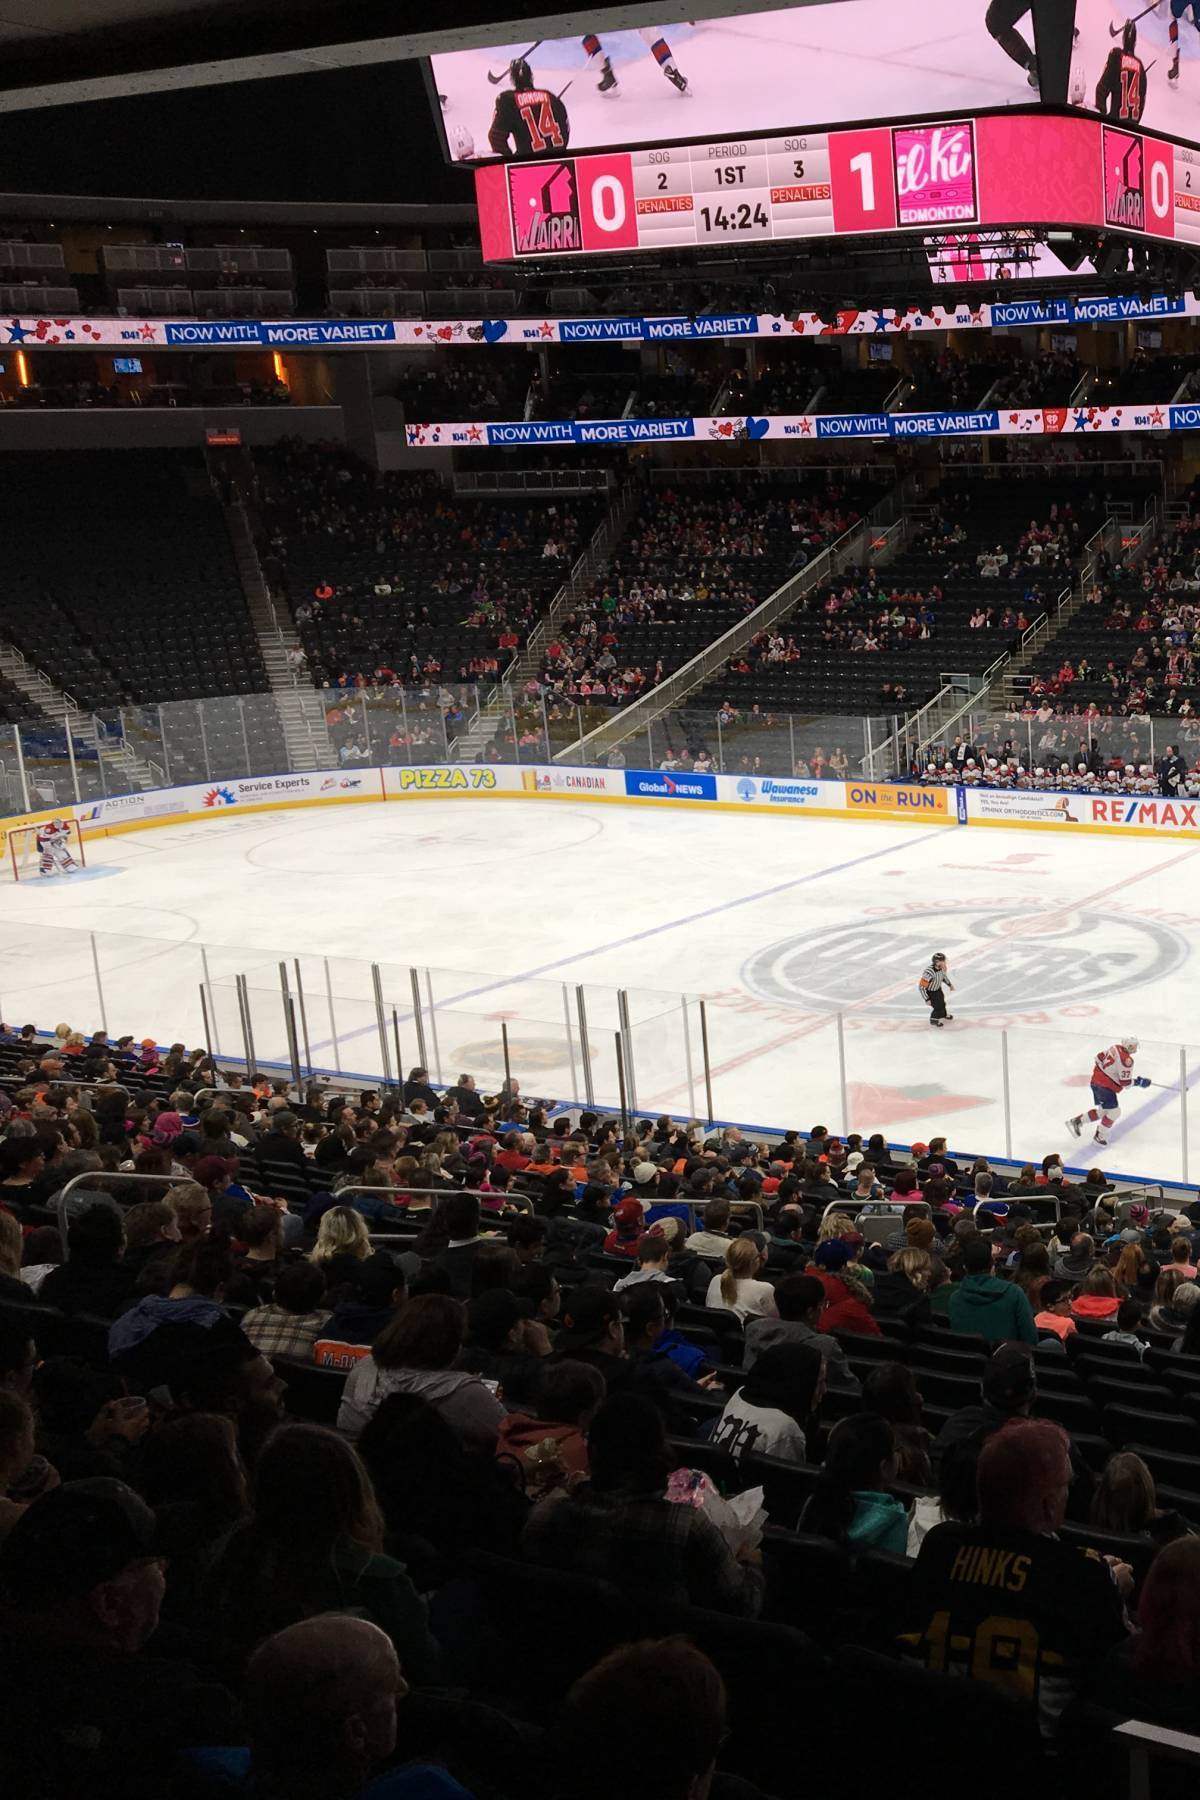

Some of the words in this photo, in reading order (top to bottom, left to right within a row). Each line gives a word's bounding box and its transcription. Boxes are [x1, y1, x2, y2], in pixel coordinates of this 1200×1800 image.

[1119, 70, 1140, 120] 14
[521, 104, 563, 152] 14
[709, 144, 746, 158] PERIOD
[784, 139, 807, 150] SOG
[649, 152, 670, 164] SOG
[715, 166, 746, 184] 1ST
[794, 160, 804, 178] 3
[658, 172, 668, 190] 2
[850, 152, 876, 211] 1
[1151, 160, 1169, 218] 0
[1186, 172, 1191, 188] 2
[591, 174, 626, 232] 0
[772, 186, 830, 202] PENALTIES
[638, 197, 693, 213] PENALTIES
[900, 205, 974, 223] EDMONTON
[701, 203, 768, 232] 14:24
[996, 308, 1029, 322] NOW
[1074, 303, 1118, 320] MORE
[170, 326, 213, 340] NOW
[216, 325, 258, 339] WITH
[268, 327, 320, 342] MORE
[321, 324, 388, 340] VARIETY
[564, 324, 603, 338] NOW
[606, 322, 640, 336] WITH
[649, 322, 692, 337] MORE
[694, 318, 752, 334] VARIETY
[492, 428, 531, 441] NOW
[534, 426, 572, 439] WITH
[581, 426, 626, 440] MORE
[628, 422, 688, 438] VARIETY
[820, 418, 854, 434] NOW
[856, 417, 888, 432] WITH
[894, 418, 934, 434] MORE
[936, 414, 994, 431] VARIETY
[238, 782, 272, 793] Service
[275, 778, 310, 791] Experts
[400, 768, 468, 790] PIZZA
[470, 768, 496, 788] 73
[566, 776, 606, 790] CANADIAN
[762, 780, 818, 796] Wawanesa
[639, 782, 668, 794] Global
[676, 784, 704, 795] NEWS
[105, 796, 144, 808] ACTION
[850, 788, 876, 804] ON
[896, 792, 934, 808] RUN
[1092, 800, 1198, 827] RE/MAX
[950, 1545, 1032, 1592] HINKS
